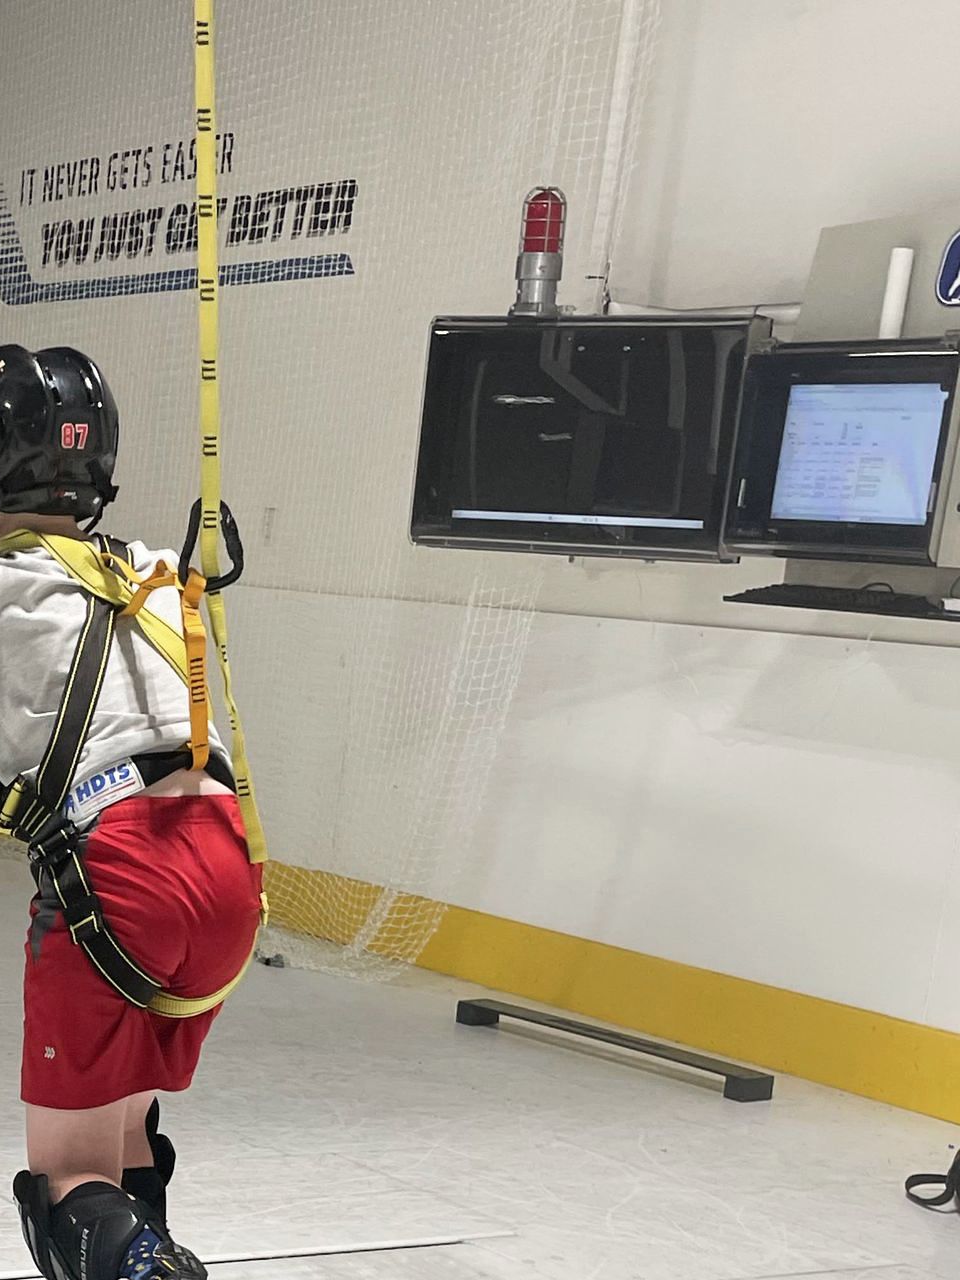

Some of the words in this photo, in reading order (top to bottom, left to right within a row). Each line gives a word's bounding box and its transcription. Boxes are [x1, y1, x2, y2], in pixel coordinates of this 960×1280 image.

[20, 169, 36, 207] IT
[42, 157, 100, 203] NEVER
[107, 146, 153, 192] GETS
[161, 133, 234, 184] EASR
[41, 217, 95, 268] YOU
[94, 207, 165, 263] JUST
[226, 179, 358, 248] BETTER
[61, 423, 88, 449] 87
[75, 762, 130, 802] HDTS
